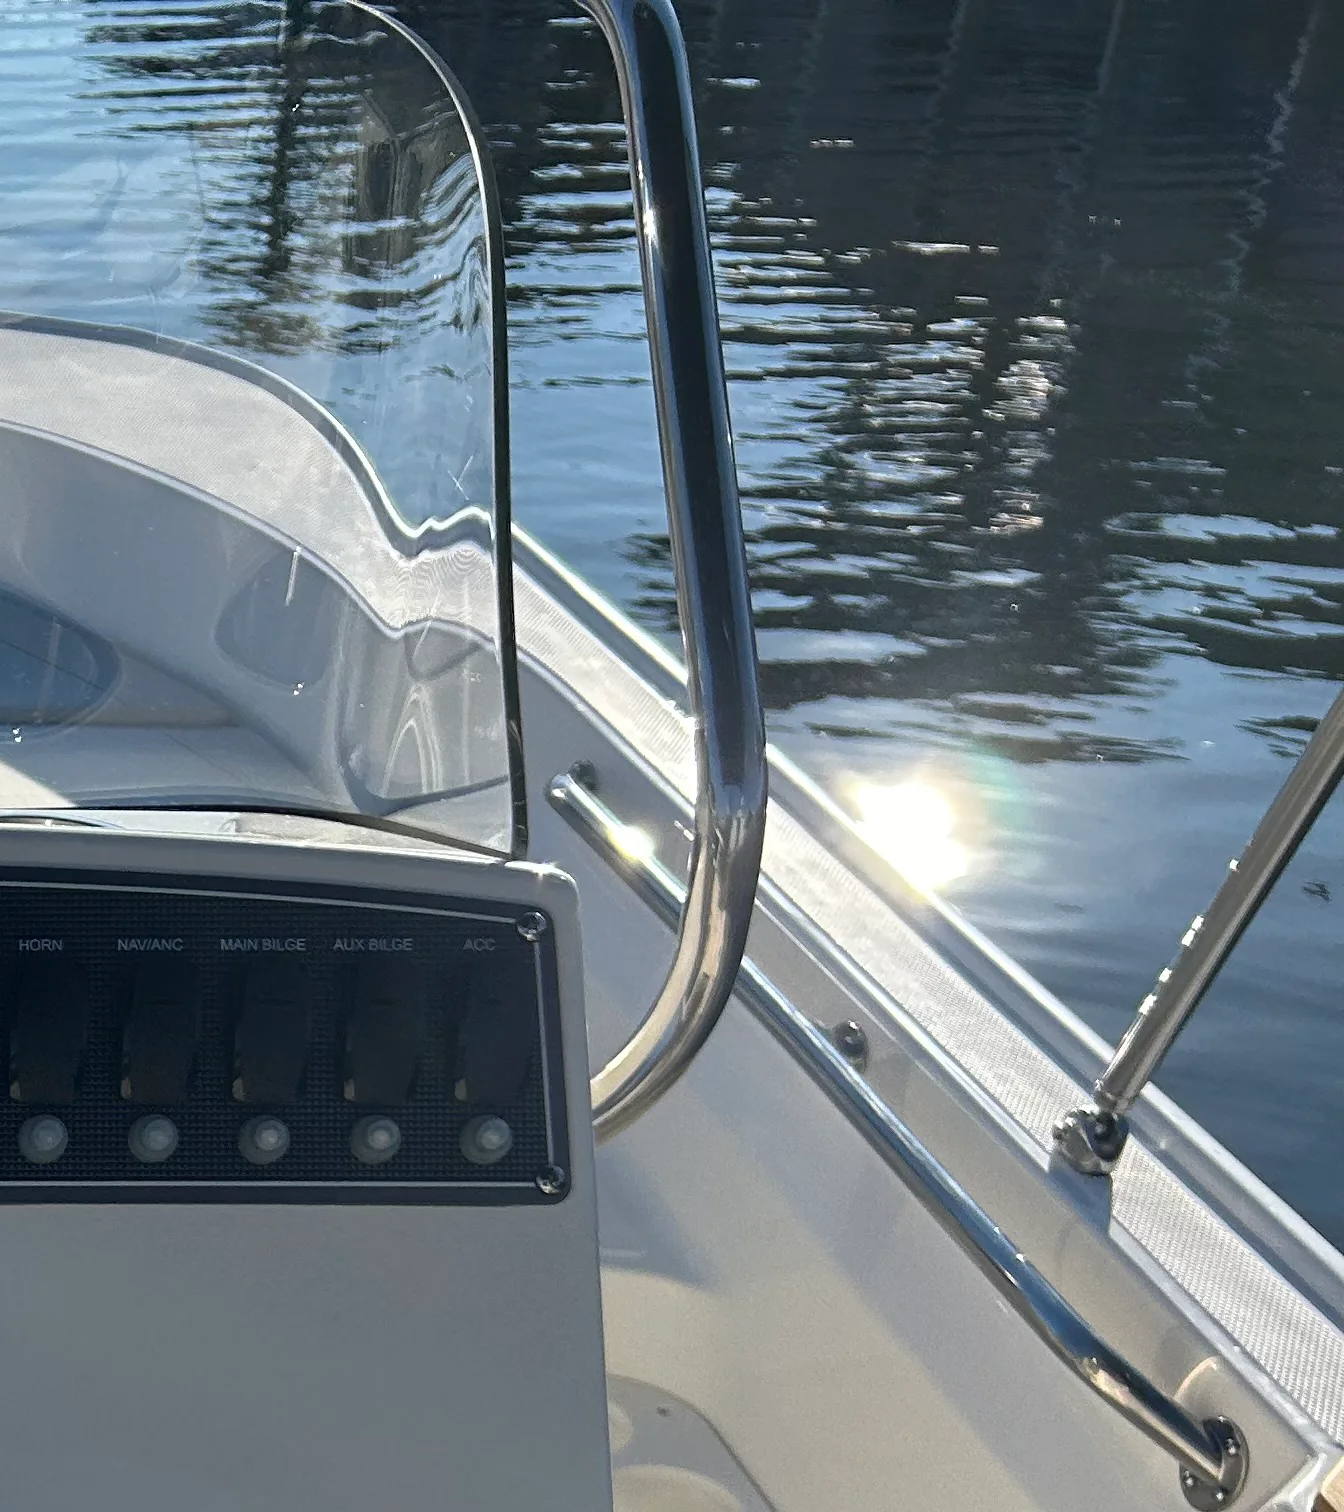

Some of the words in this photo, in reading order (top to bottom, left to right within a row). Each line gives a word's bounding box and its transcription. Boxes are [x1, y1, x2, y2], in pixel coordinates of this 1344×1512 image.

[18, 938, 63, 952] HORN
[117, 938, 185, 952] NAV/ANC
[220, 938, 258, 952] MAIN
[261, 938, 307, 952] BILGE
[333, 938, 365, 952] AUX
[368, 938, 413, 952] BILGE
[462, 938, 497, 952] ACC
